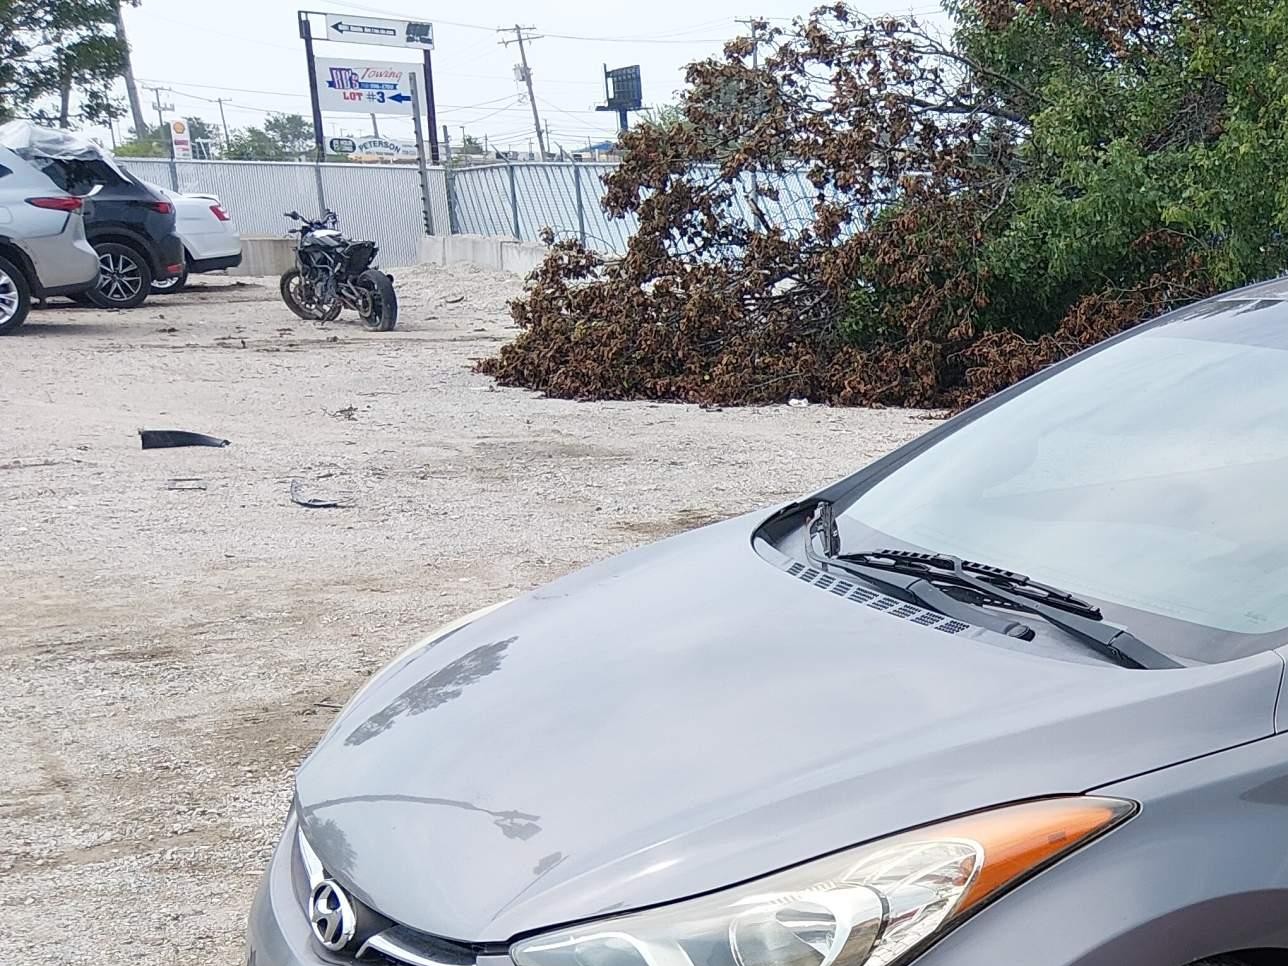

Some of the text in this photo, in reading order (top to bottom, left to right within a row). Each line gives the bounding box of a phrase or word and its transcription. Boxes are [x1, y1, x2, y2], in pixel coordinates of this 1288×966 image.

[361, 67, 402, 82] Towing
[343, 91, 386, 104] LOT #3
[358, 140, 401, 153] PETERSON
